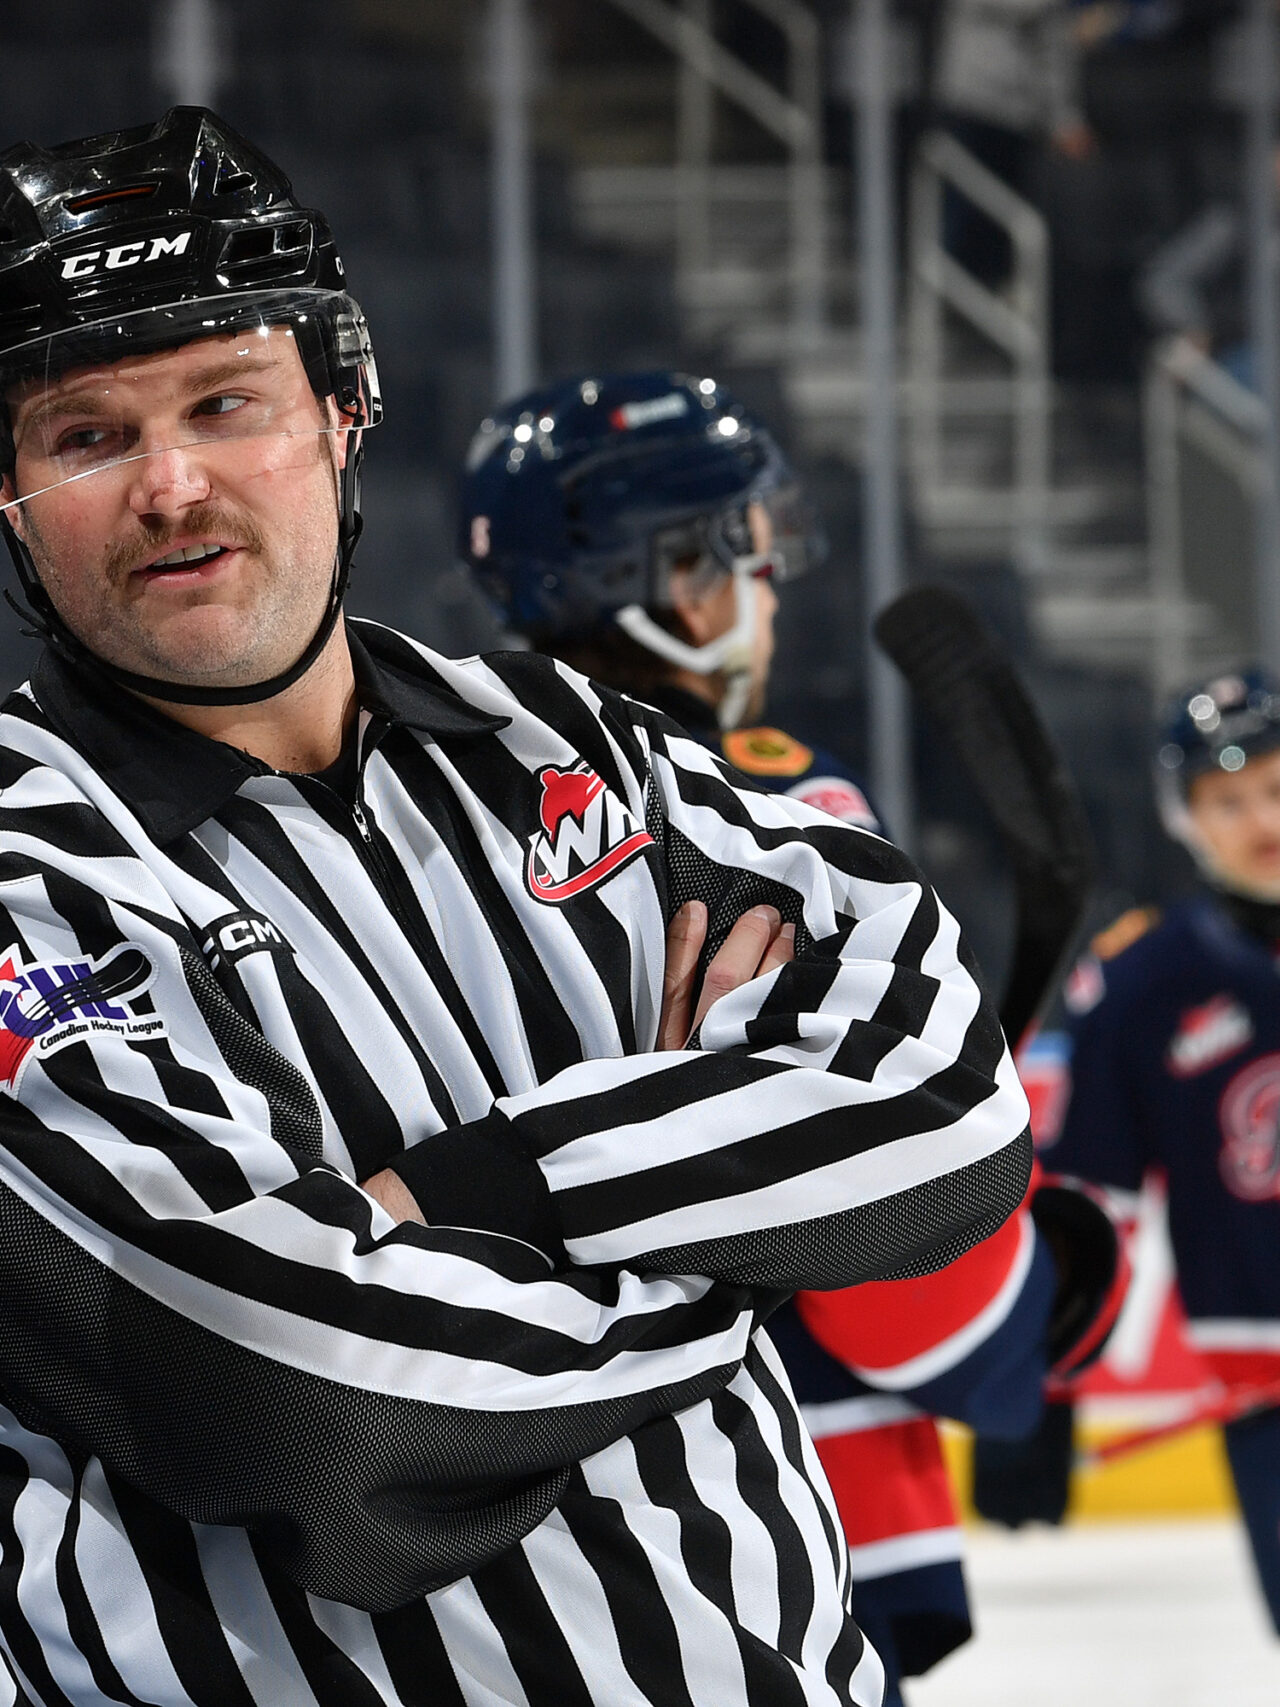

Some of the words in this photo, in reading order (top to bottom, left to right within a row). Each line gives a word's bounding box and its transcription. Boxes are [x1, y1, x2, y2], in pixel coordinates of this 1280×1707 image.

[60, 232, 191, 280] CCM
[0, 963, 128, 1039] CHL
[40, 1023, 89, 1050] Canadian
[91, 1020, 124, 1035] Hockey
[127, 1020, 164, 1035] League
